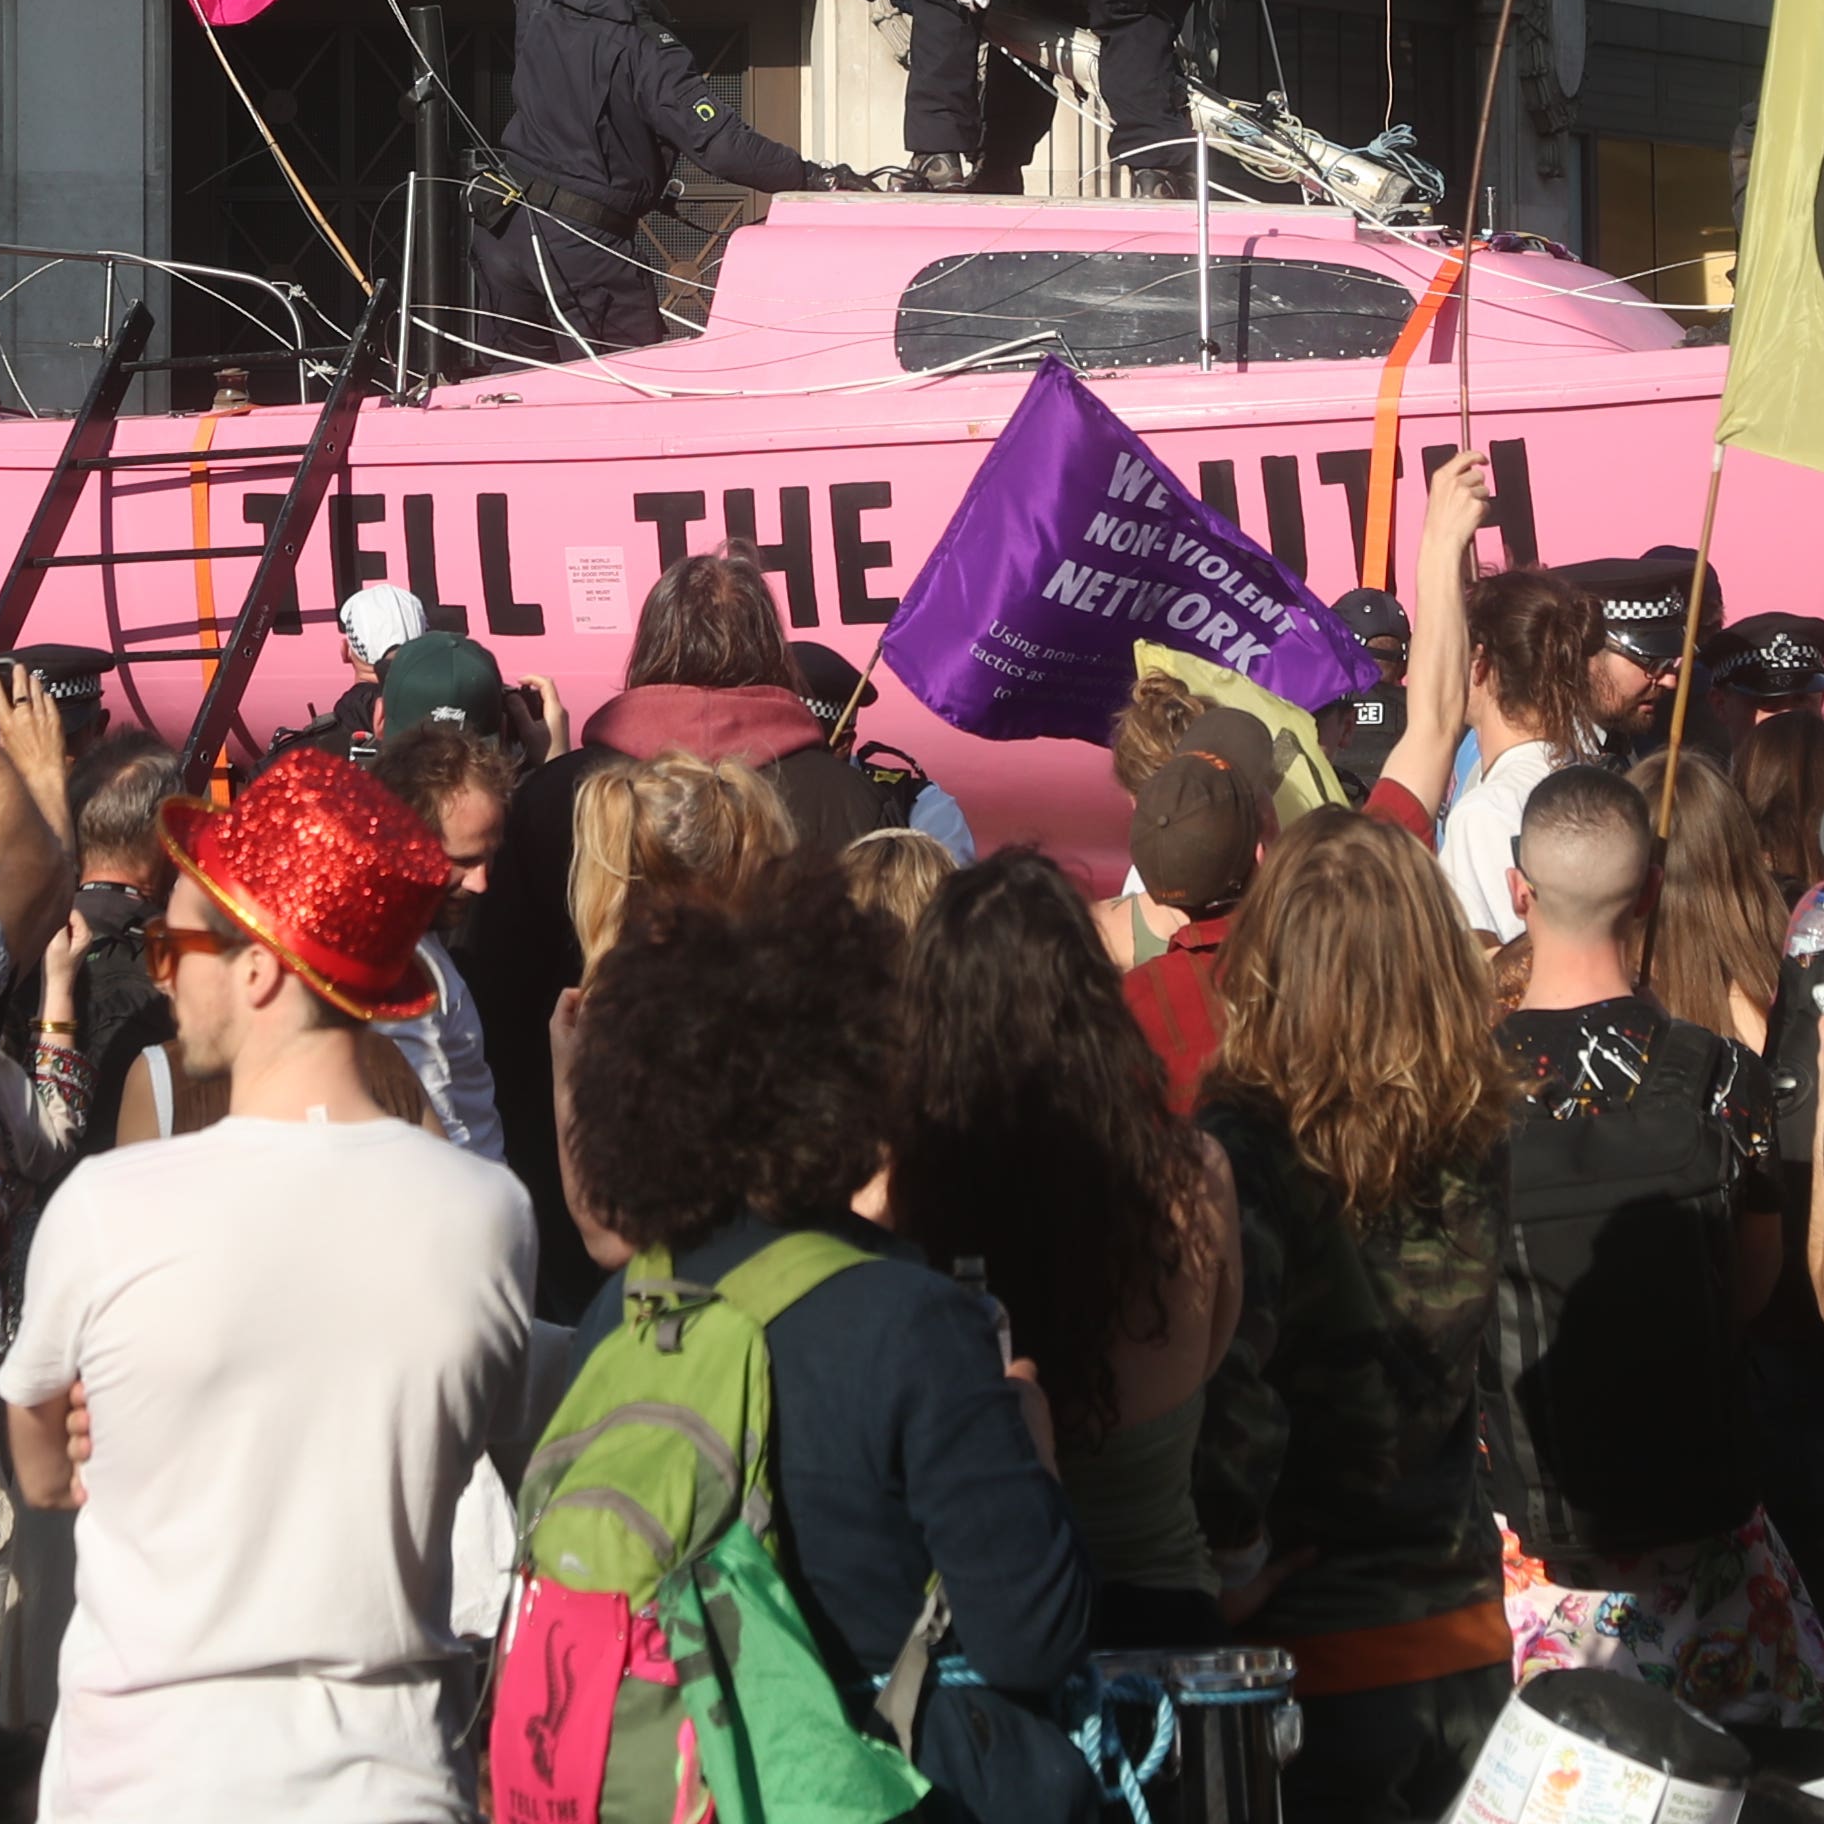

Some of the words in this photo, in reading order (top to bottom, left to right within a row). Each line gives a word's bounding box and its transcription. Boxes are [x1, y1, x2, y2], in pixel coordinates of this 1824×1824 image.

[1107, 451, 1172, 510] WE
[243, 493, 546, 636] TELL
[633, 481, 900, 628] THE
[1083, 512, 1297, 636] NON-VIOLENT
[988, 619, 1041, 660] Using
[1042, 559, 1272, 676] NETWORK
[969, 642, 1026, 678] tactics
[1027, 667, 1046, 682] as
